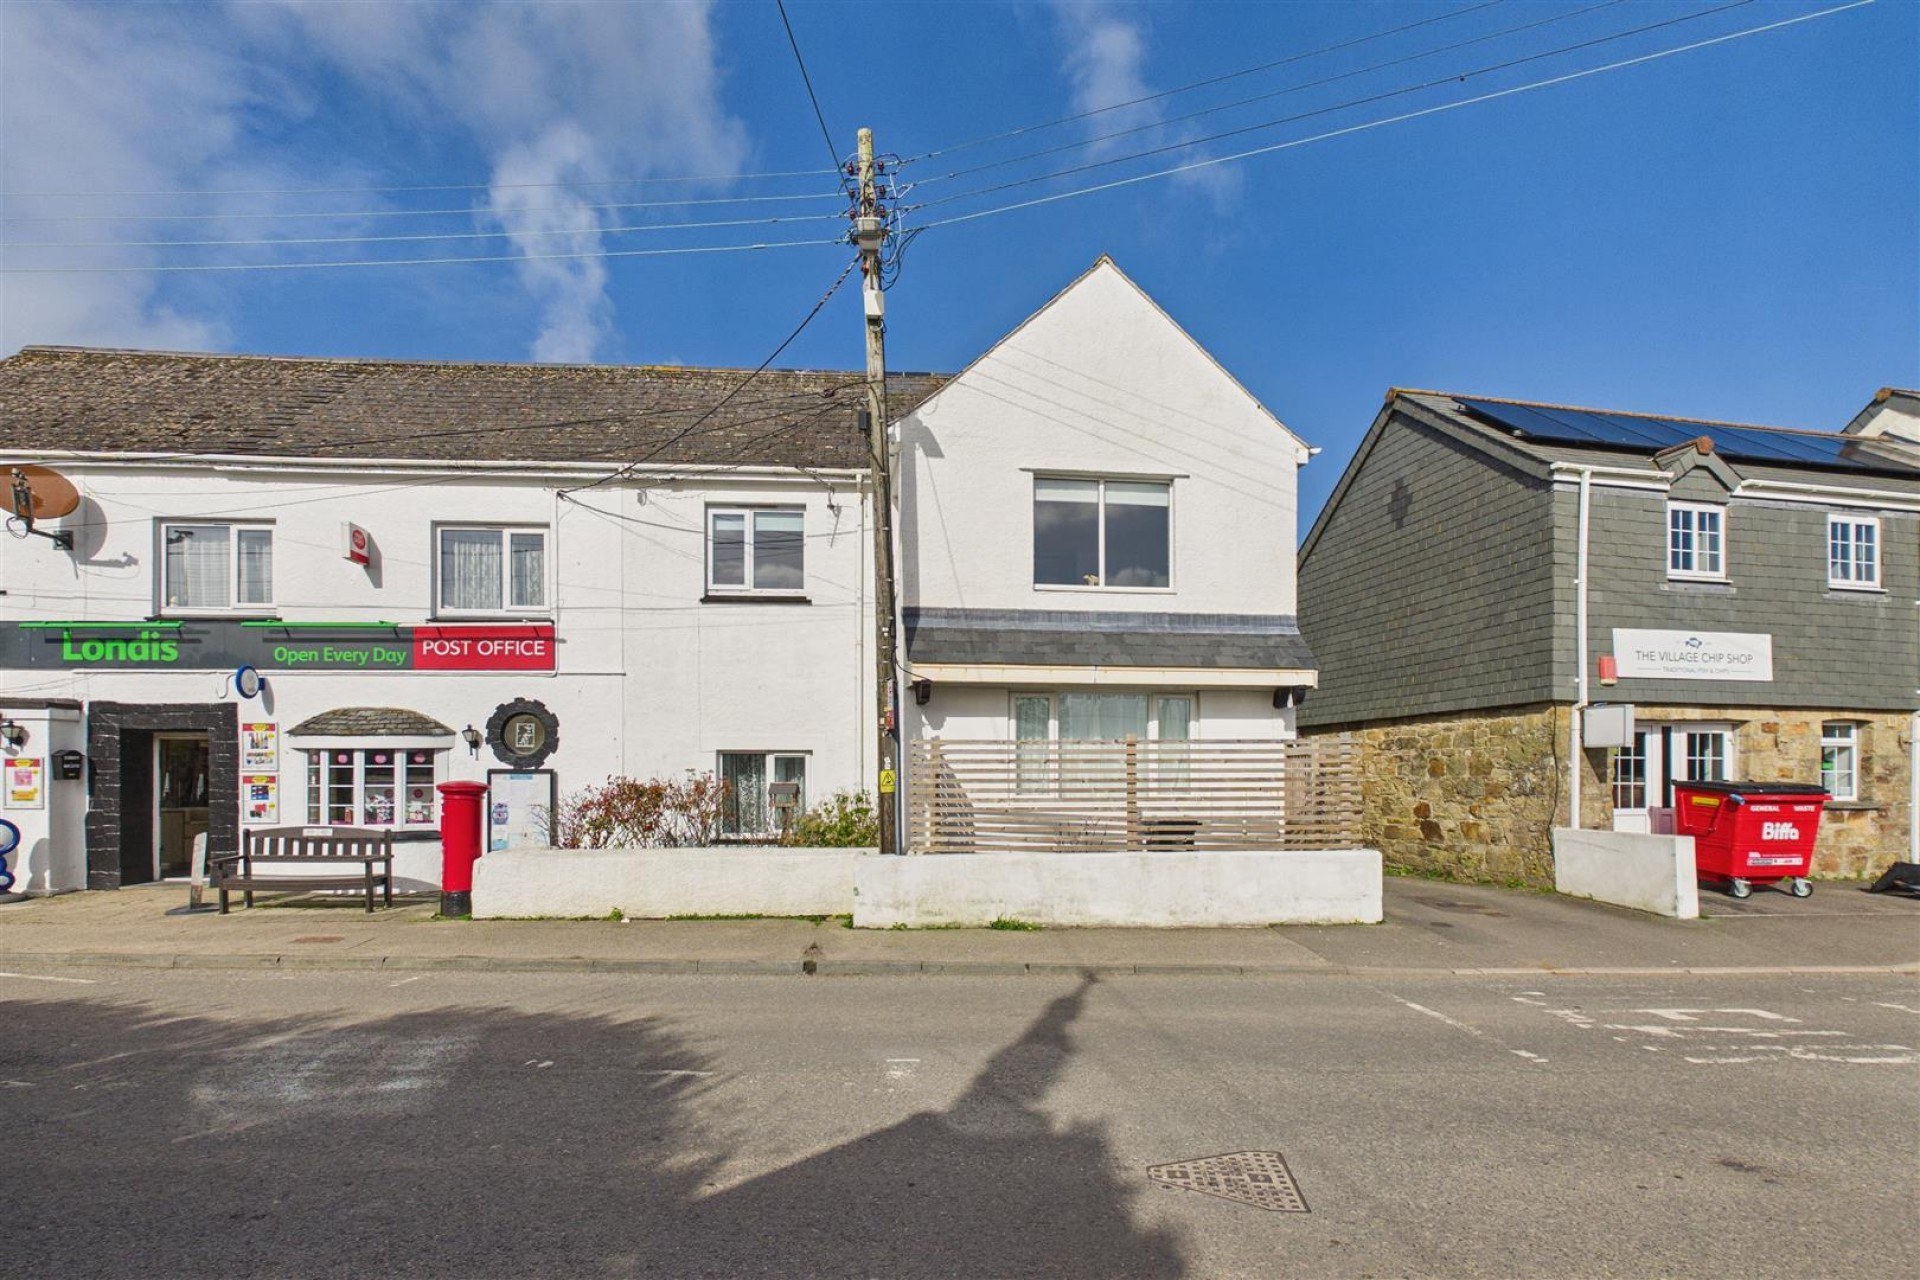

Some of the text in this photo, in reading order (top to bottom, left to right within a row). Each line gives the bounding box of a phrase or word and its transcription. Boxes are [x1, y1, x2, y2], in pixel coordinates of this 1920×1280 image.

[63, 630, 179, 662] Londis
[422, 640, 545, 656] POST OFFICE
[274, 646, 407, 666] Open Every Day
[1636, 651, 1754, 665] THE VILLAGE CHIP SHOP
[1762, 822, 1799, 840] Biffa
